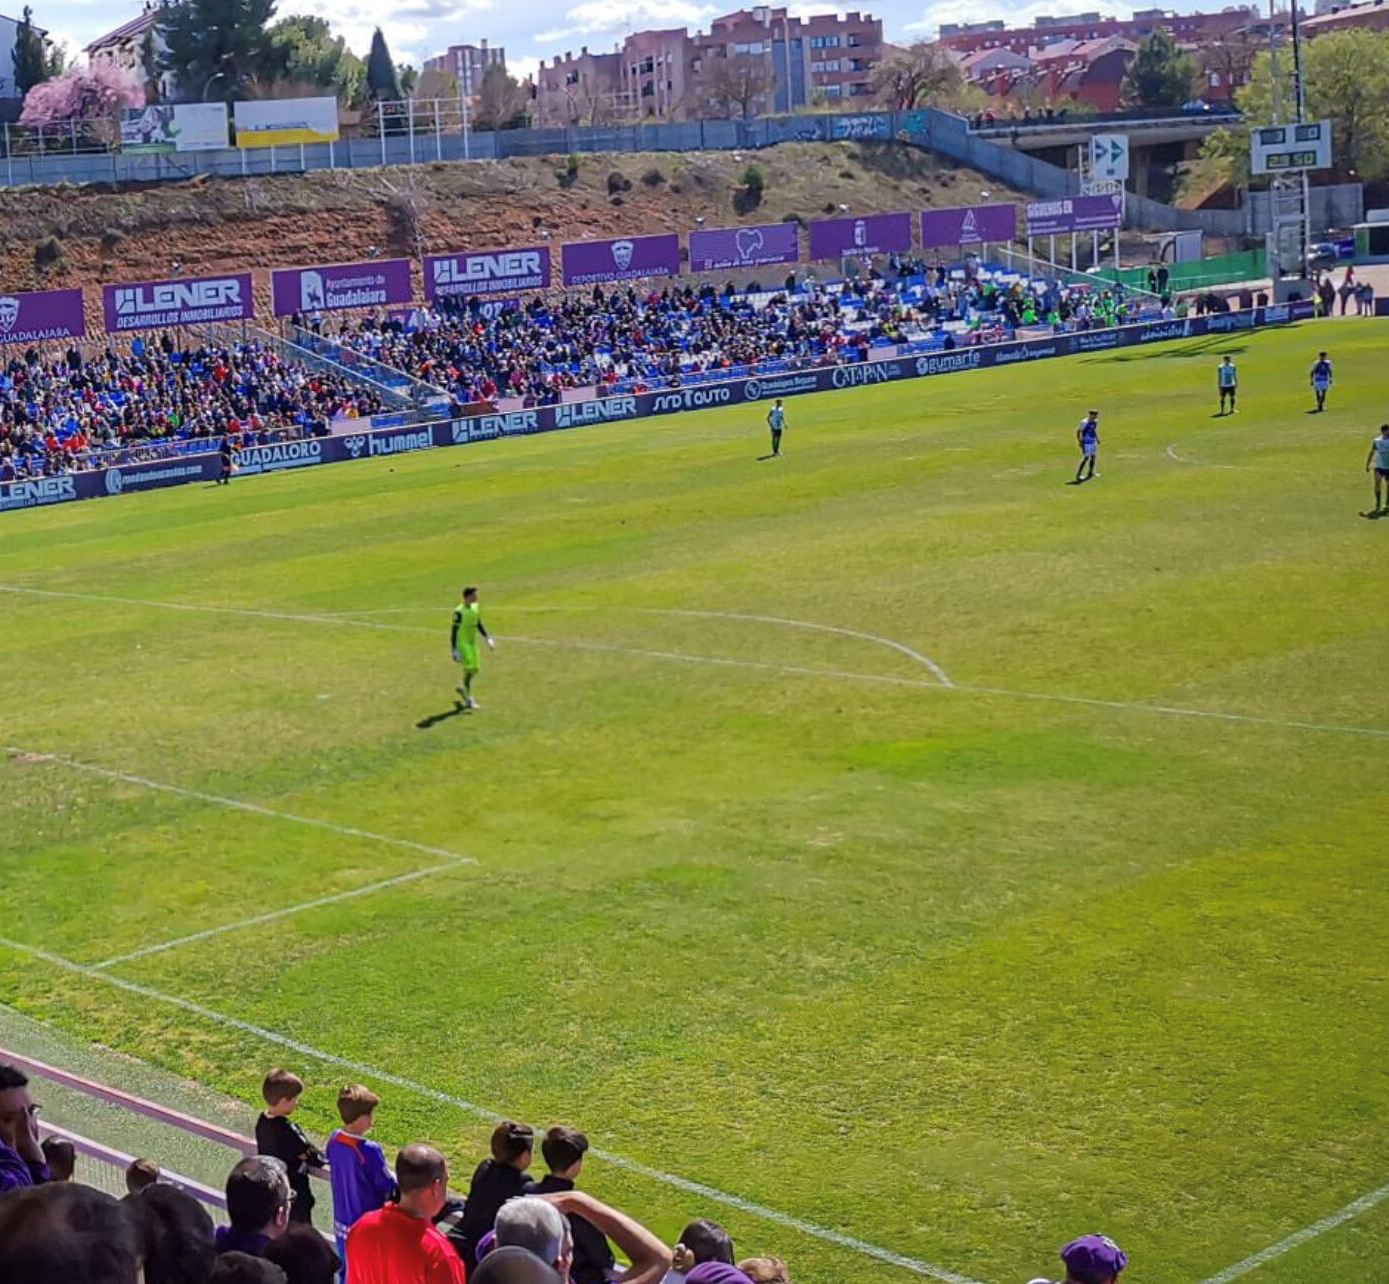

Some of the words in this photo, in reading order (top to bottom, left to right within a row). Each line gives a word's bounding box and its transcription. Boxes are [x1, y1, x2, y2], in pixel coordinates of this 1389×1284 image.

[451, 251, 542, 282] LENER
[135, 279, 242, 313] LENER
[326, 287, 387, 307] Guadalajara
[117, 311, 178, 328] DESARROLLOS
[180, 306, 243, 322] INMOBILIARIOS
[928, 350, 981, 374] gumarfe
[571, 396, 637, 422] LENER
[468, 411, 538, 437] LENER
[231, 440, 321, 466] GUADALORO
[368, 425, 433, 456] hummel
